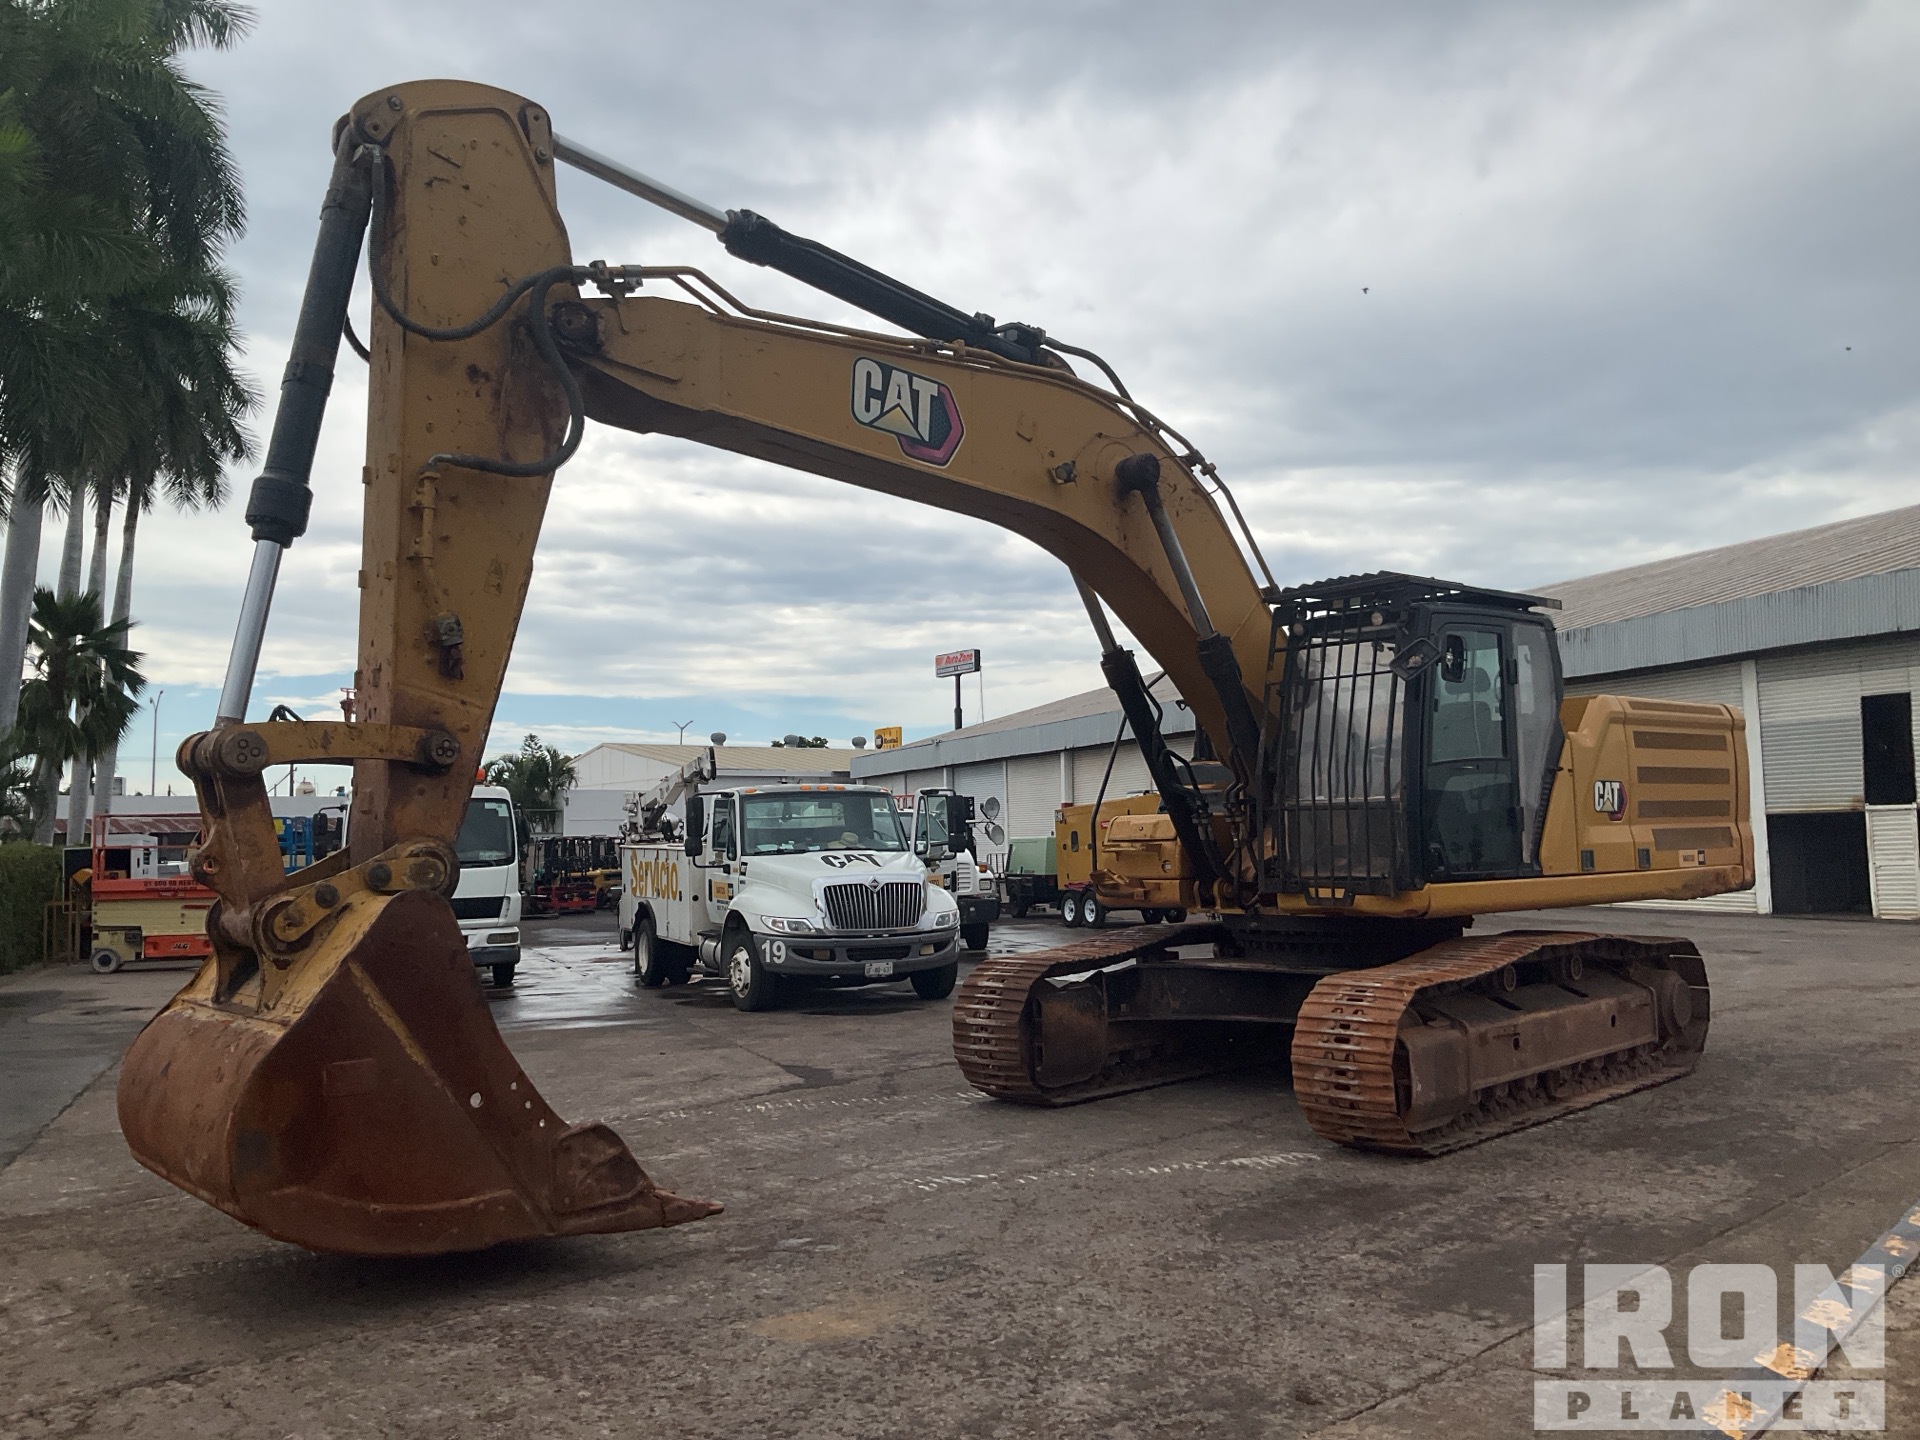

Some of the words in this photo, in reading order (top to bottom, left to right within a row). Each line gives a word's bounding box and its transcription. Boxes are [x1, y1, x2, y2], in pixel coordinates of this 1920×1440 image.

[853, 358, 938, 442] CAT
[945, 652, 973, 665] AutoZone
[1594, 781, 1620, 812] CAT
[631, 849, 678, 901] Servicio
[821, 854, 882, 869] CAT
[761, 940, 786, 964] 19
